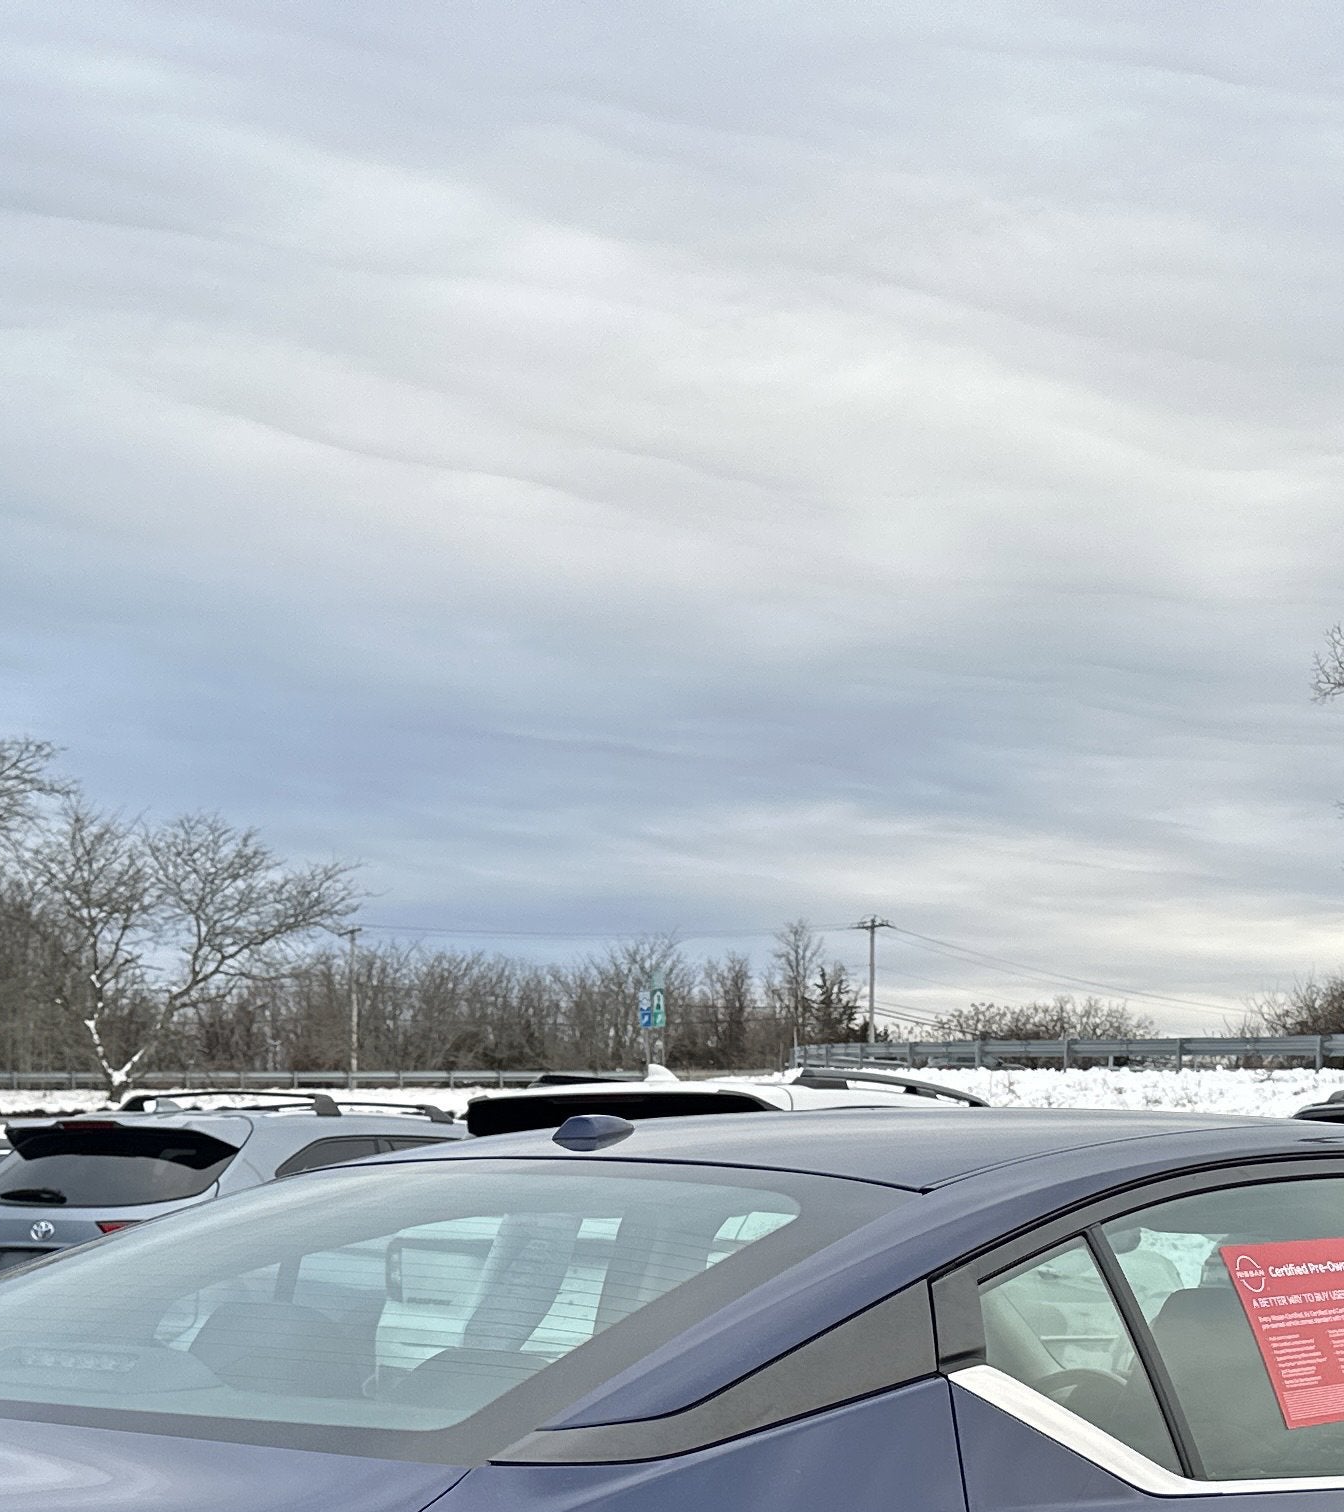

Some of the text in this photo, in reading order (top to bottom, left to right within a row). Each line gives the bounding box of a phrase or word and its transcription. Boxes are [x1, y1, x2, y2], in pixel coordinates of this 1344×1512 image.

[1269, 1263, 1309, 1278] Certified
[1252, 1299, 1260, 1309] A
[1258, 1295, 1288, 1308] BETTER
[1286, 1294, 1303, 1305] WAY
[1302, 1293, 1314, 1303] TO
[1313, 1291, 1330, 1302] BUY
